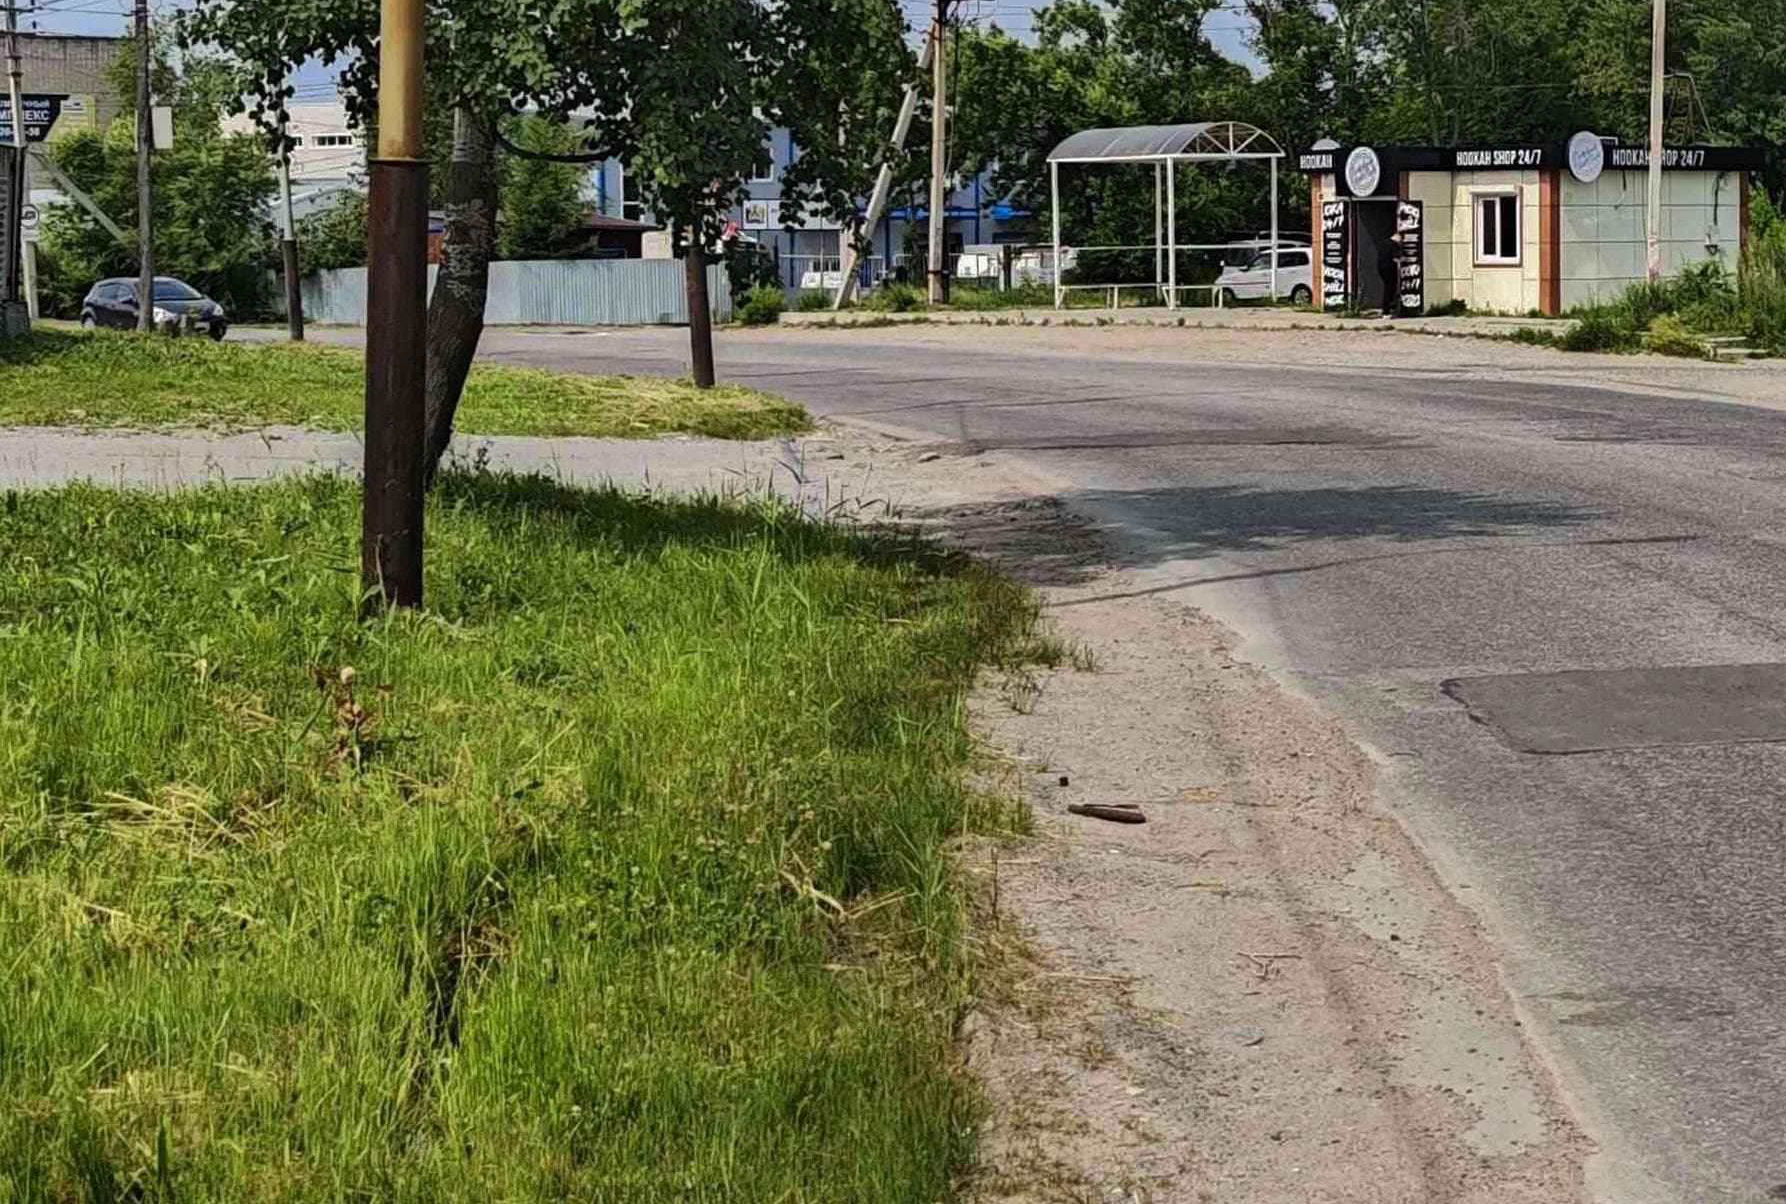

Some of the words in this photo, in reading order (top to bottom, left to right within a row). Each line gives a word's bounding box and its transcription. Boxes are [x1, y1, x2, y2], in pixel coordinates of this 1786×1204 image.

[1456, 150, 1491, 166] HOOKAH
[1493, 150, 1517, 165] SHOP
[1518, 148, 1542, 165] 24/7
[1680, 149, 1705, 167] 24/7
